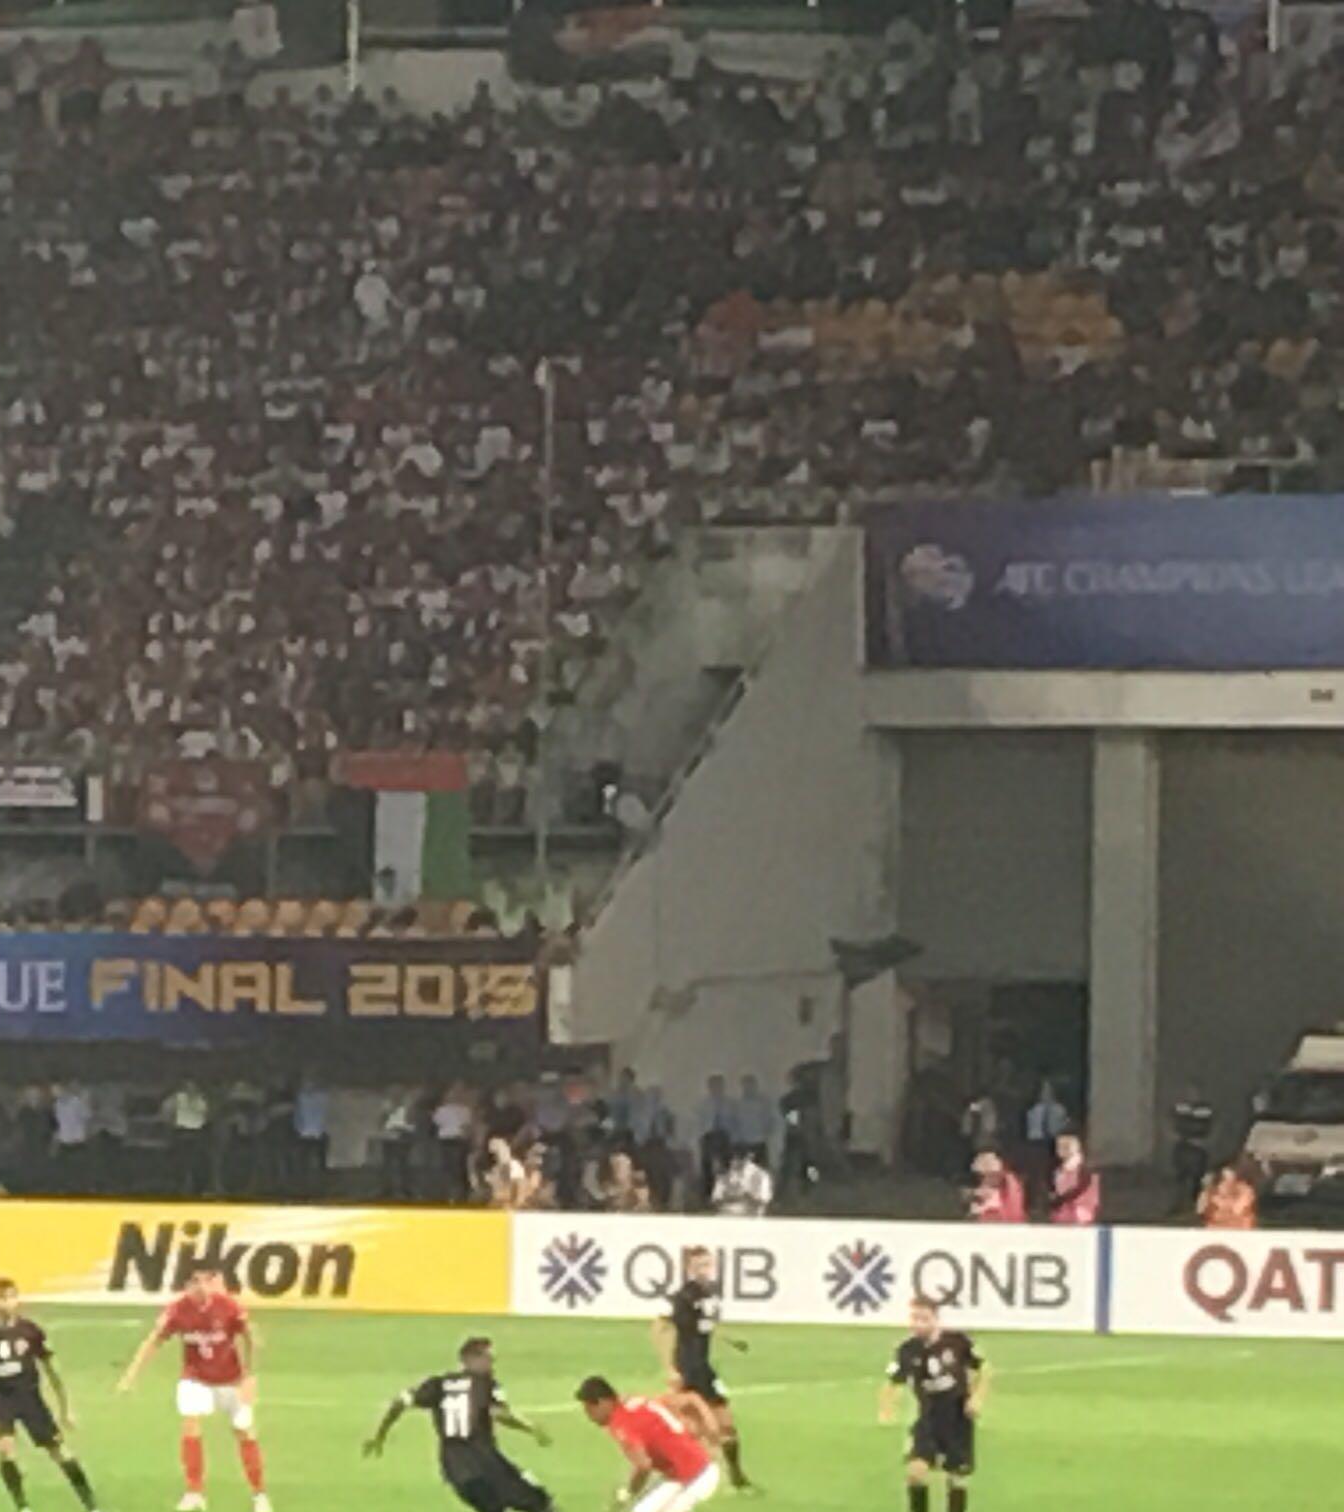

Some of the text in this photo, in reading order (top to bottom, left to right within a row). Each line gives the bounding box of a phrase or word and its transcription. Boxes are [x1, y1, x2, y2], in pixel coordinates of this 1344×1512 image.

[90, 961, 326, 1016] FINAL
[346, 964, 538, 1019] 2015
[912, 1249, 1070, 1308] QNB
